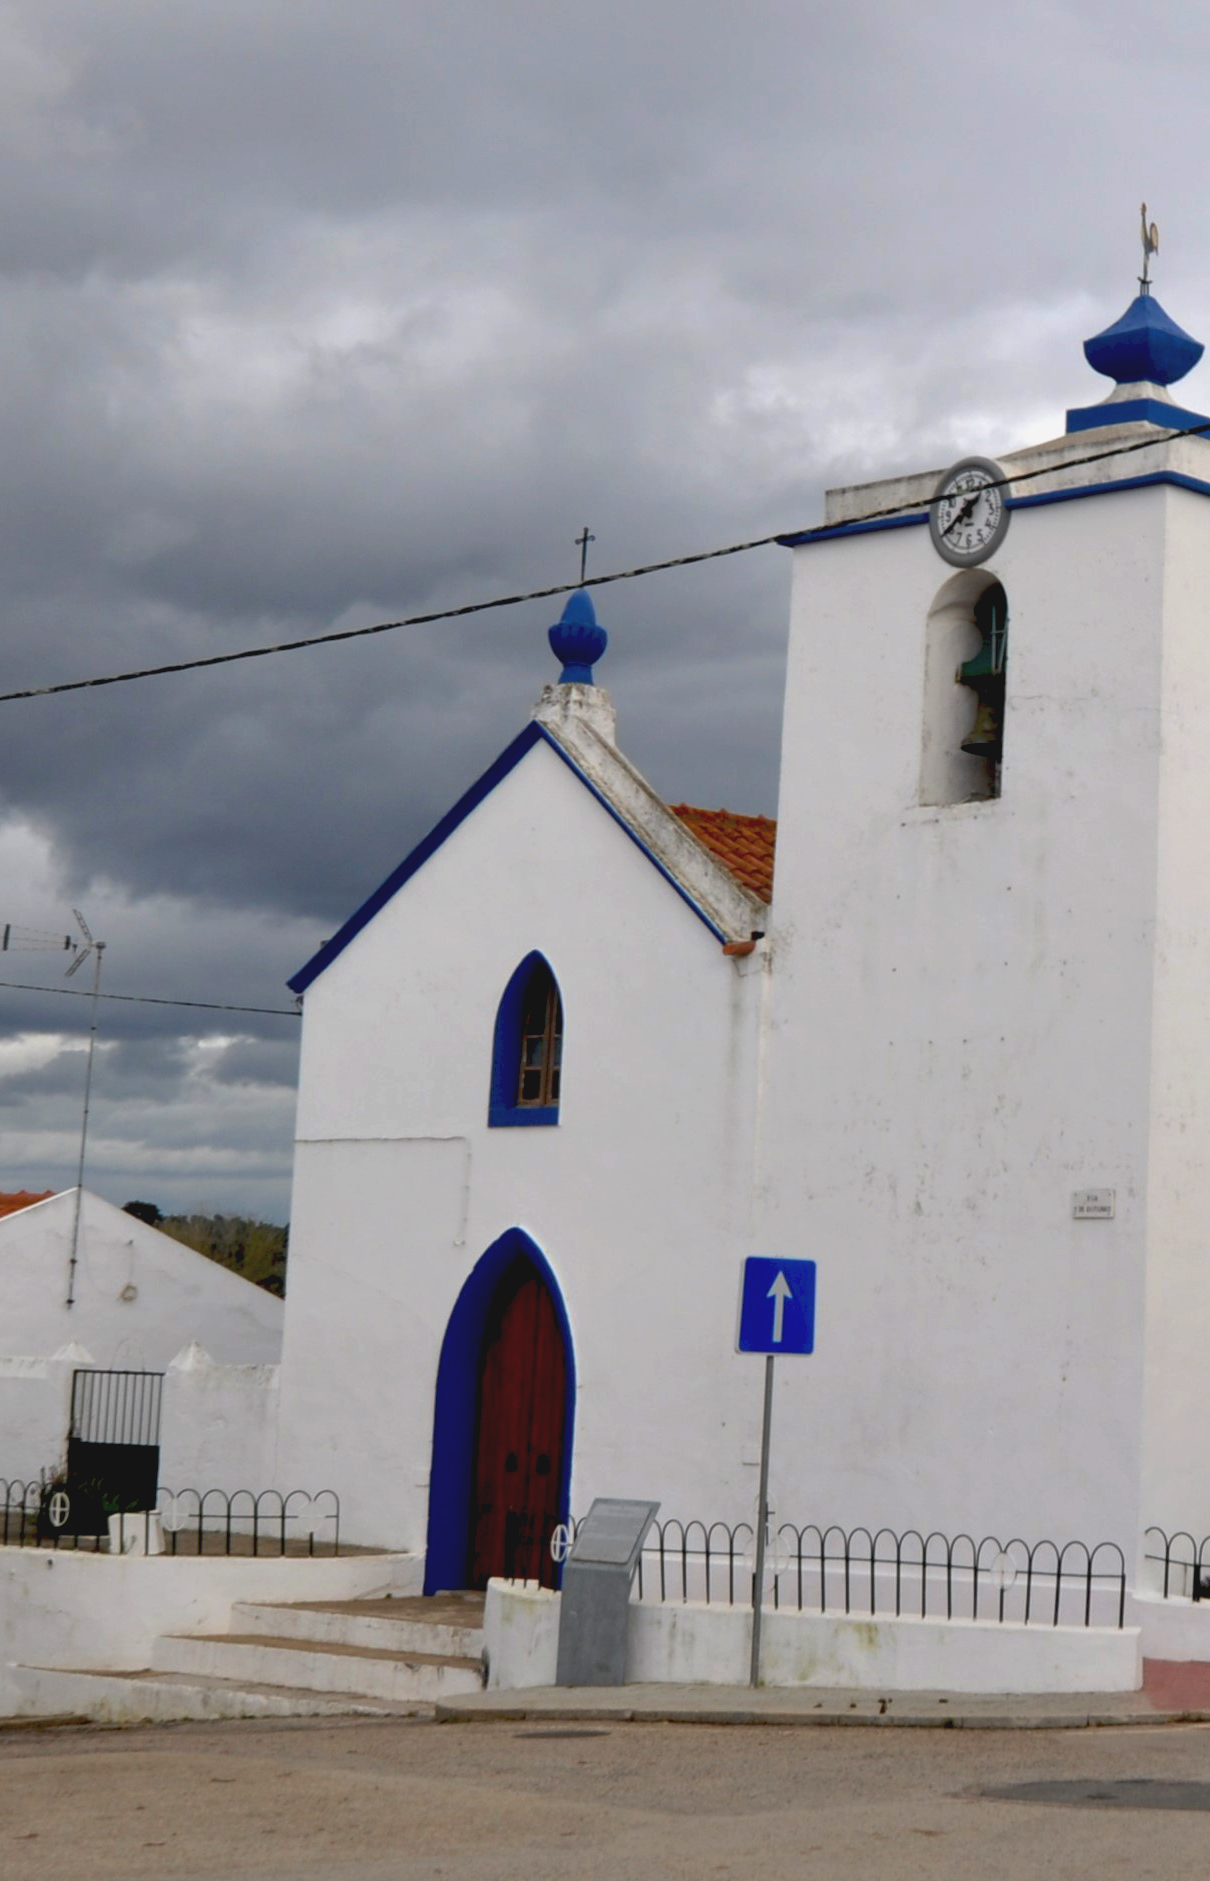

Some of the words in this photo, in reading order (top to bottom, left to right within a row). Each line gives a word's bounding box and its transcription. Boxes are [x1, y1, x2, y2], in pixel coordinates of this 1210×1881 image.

[985, 489, 991, 502] 2
[988, 503, 995, 516] 3
[946, 510, 952, 523] 9
[957, 531, 963, 544] 7
[966, 533, 972, 546] 6
